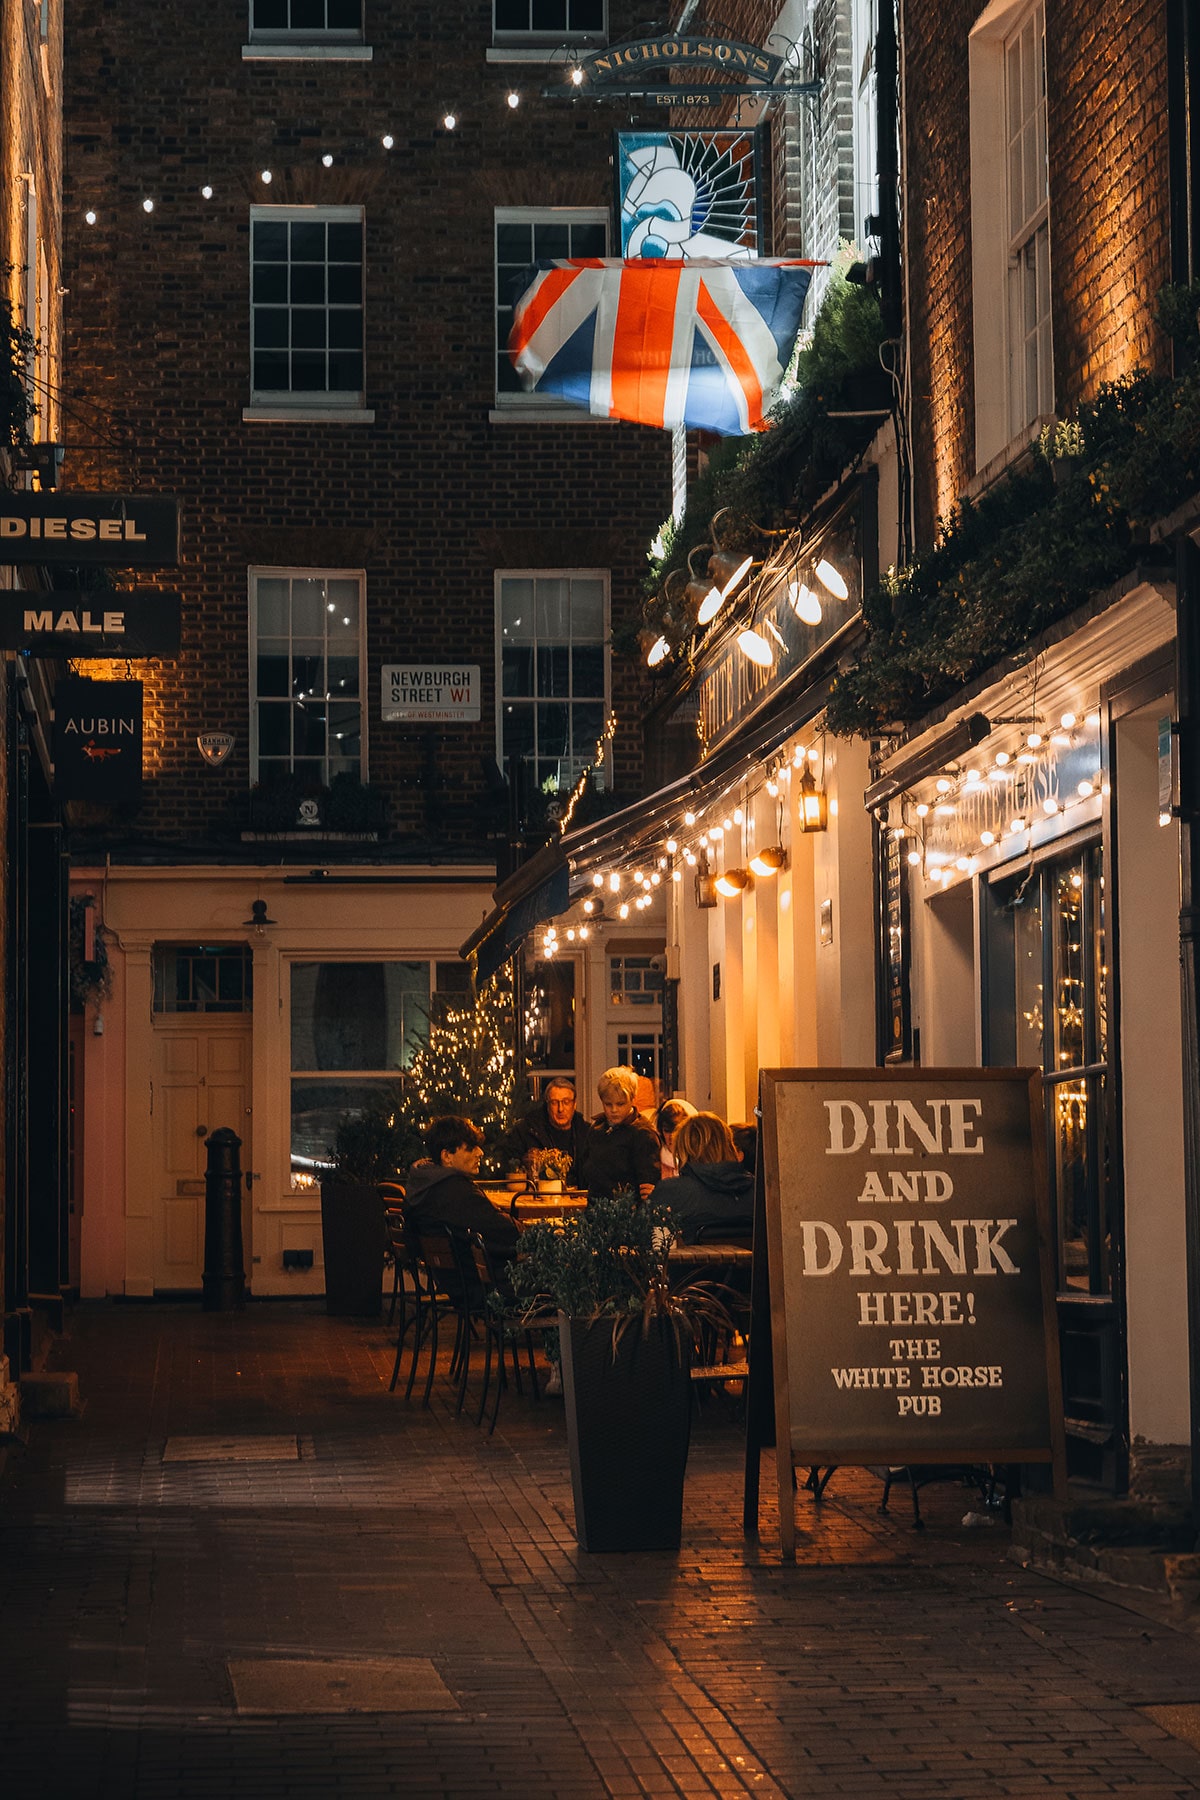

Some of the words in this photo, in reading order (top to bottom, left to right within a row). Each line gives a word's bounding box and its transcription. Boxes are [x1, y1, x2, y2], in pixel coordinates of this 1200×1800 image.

[593, 42, 770, 74] NICHOLSON'S
[682, 95, 710, 105] 1873
[0, 517, 147, 540] DIESEL
[23, 610, 126, 633] MALE
[390, 671, 471, 687] NEWBURGH
[391, 688, 443, 703] STREET
[450, 688, 471, 703] W1
[407, 711, 416, 719] OF
[418, 710, 465, 719] WESTMINSTER
[64, 718, 135, 735] AUBIN
[823, 1098, 985, 1154] DINE
[857, 1170, 954, 1202] AND
[799, 1219, 1021, 1276] DRINK
[857, 1291, 977, 1325] HERE!
[889, 1339, 941, 1360] THE
[831, 1367, 911, 1389] WHITE
[921, 1366, 1003, 1388] HORSE
[897, 1396, 942, 1416] PUB
